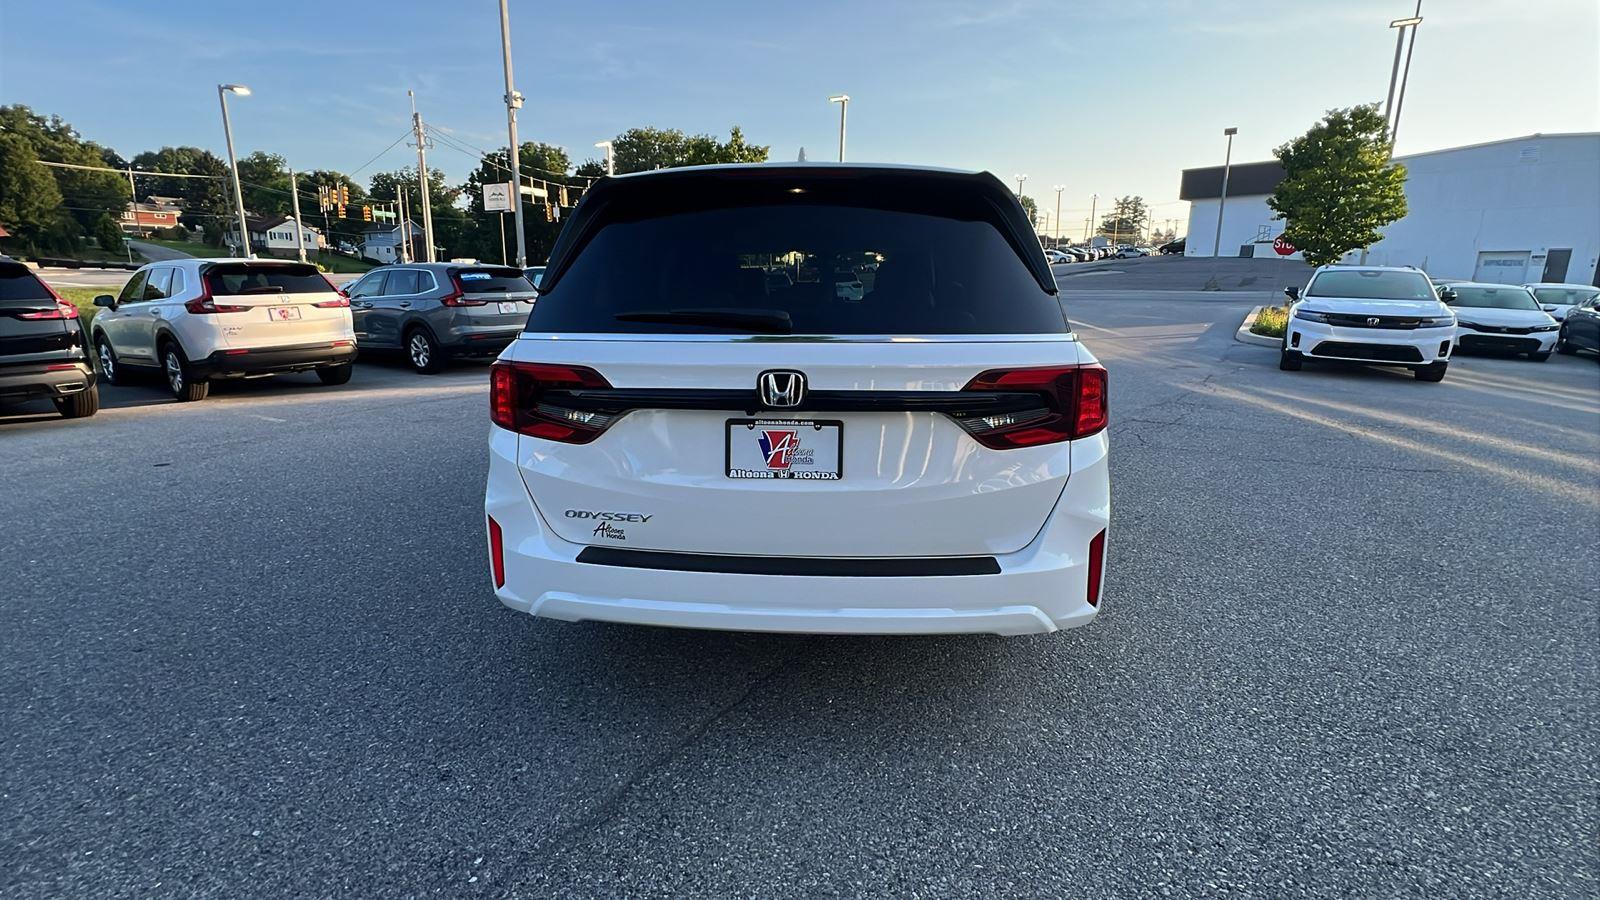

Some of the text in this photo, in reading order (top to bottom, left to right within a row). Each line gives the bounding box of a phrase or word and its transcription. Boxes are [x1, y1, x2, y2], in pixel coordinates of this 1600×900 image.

[1274, 239, 1295, 249] STO
[784, 456, 814, 465] Honda
[729, 469, 775, 479] Altoona
[793, 471, 839, 480] HONDA
[564, 510, 653, 522] ODYSSEY
[606, 532, 626, 540] Honda
